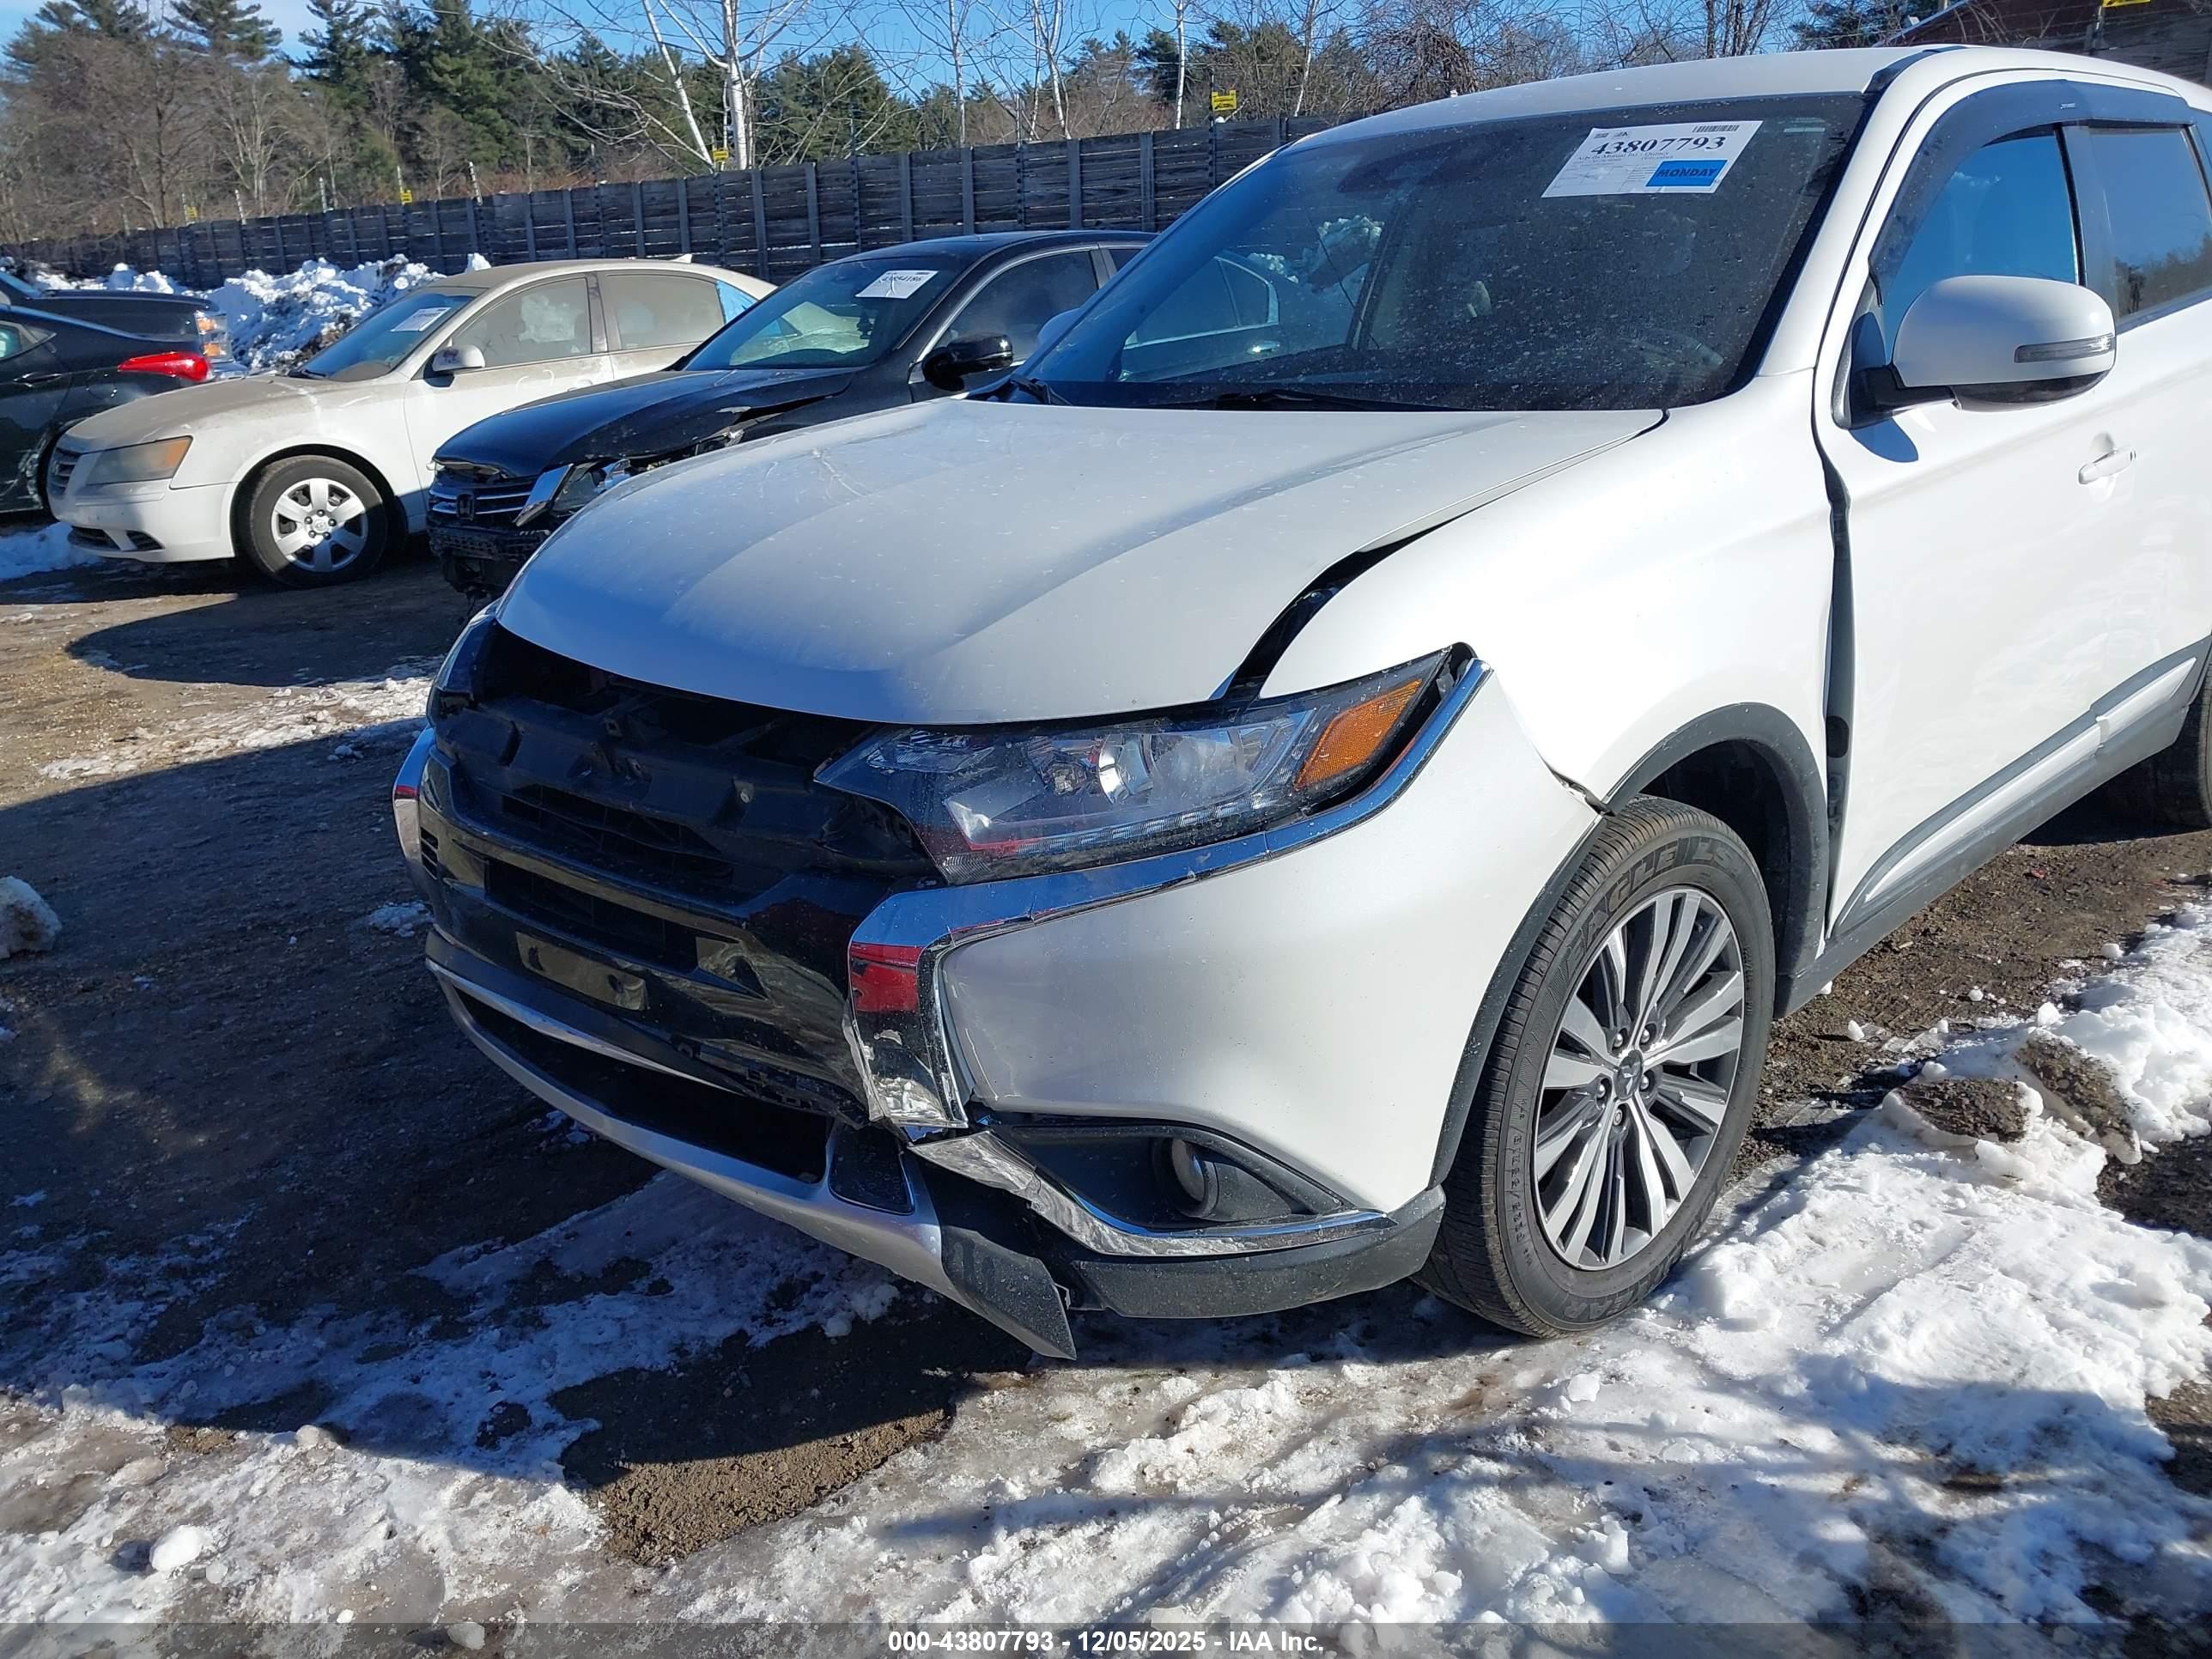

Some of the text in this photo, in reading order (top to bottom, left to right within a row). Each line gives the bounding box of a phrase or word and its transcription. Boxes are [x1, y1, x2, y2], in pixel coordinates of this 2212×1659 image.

[1591, 136, 1726, 155] 43807793
[1656, 167, 1717, 178] MONDAY
[1565, 842, 1679, 975] EAGLE
